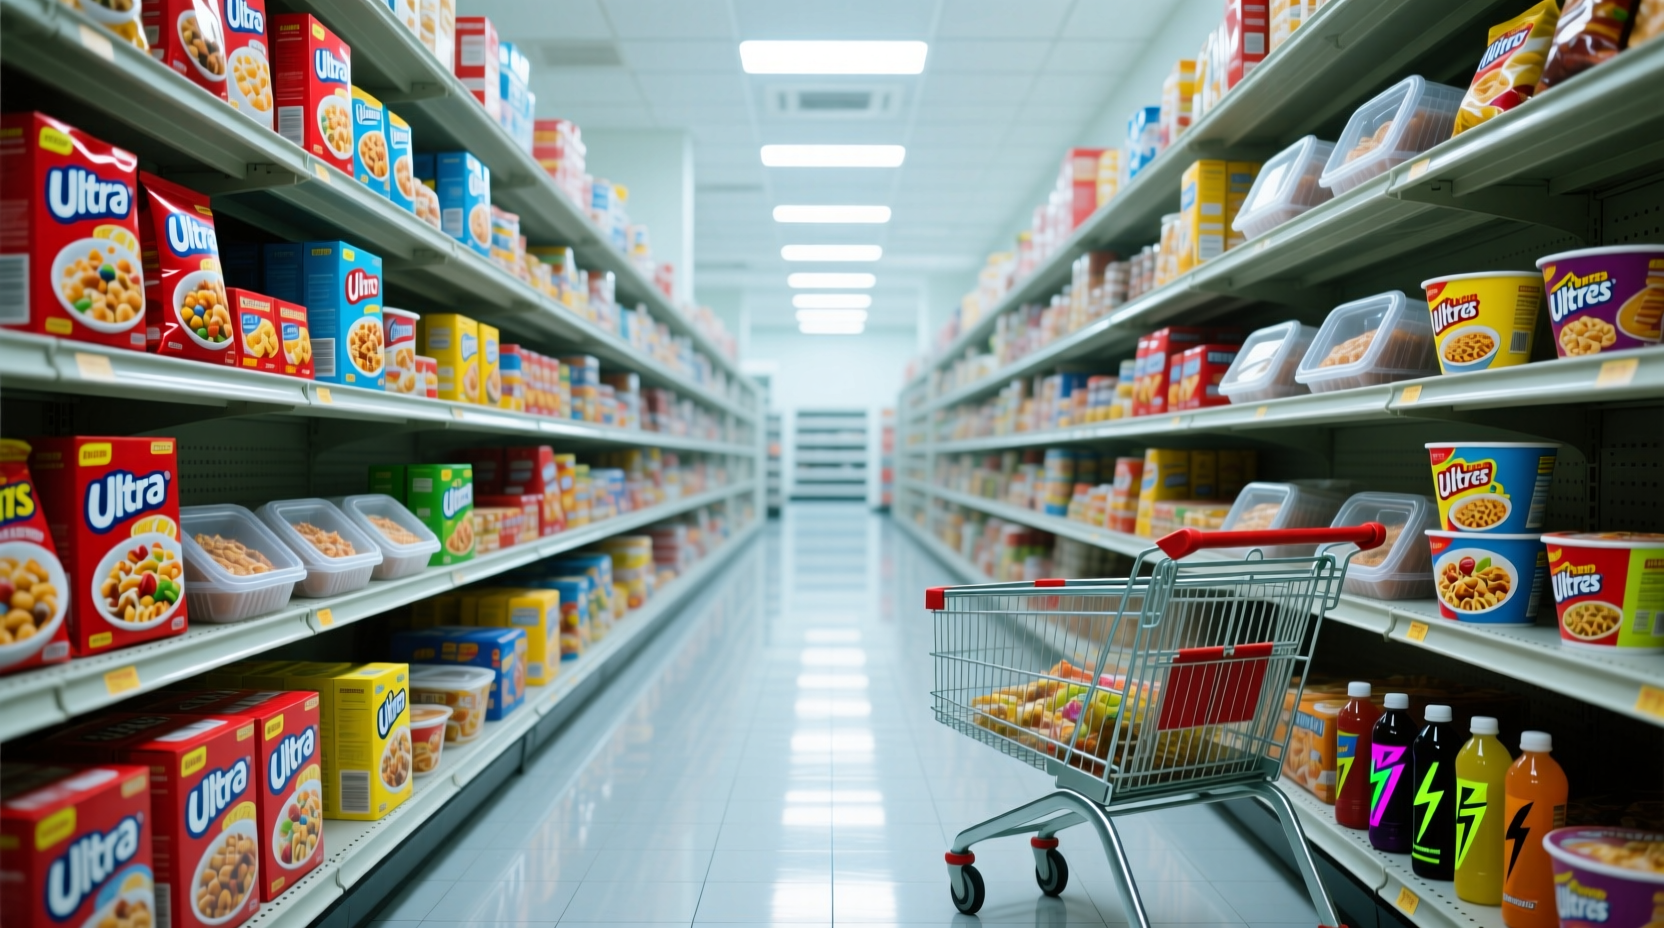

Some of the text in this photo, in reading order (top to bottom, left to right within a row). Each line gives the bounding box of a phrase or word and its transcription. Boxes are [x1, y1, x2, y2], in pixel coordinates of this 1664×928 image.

[50, 168, 129, 219] Ultra
[168, 215, 218, 253] Ultra
[1433, 301, 1477, 334] Ultres
[1550, 280, 1612, 322] Ultres
[88, 472, 165, 529] Ultra
[1438, 465, 1490, 498] Ultres
[1552, 571, 1601, 603] Ultres
[269, 725, 315, 790] Ultra
[188, 760, 248, 834] Ultra
[48, 817, 139, 917] Ultra
